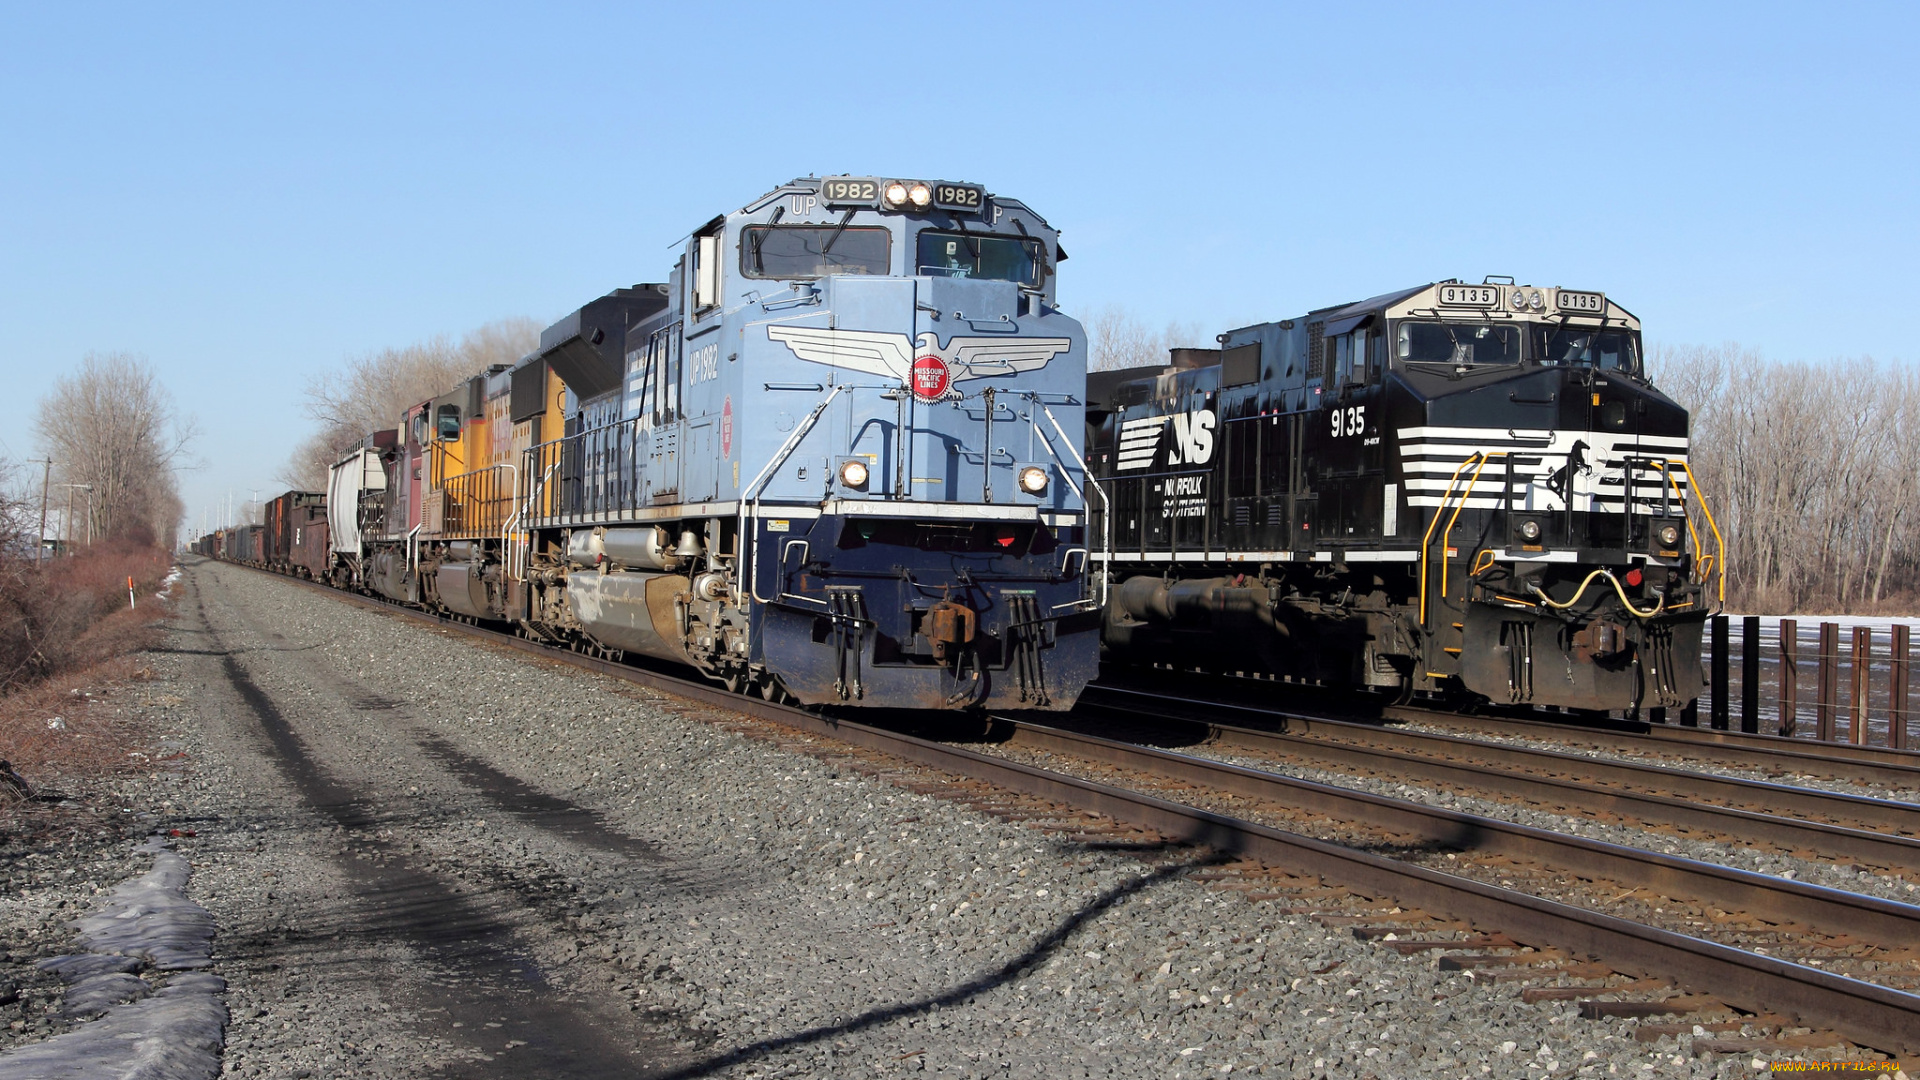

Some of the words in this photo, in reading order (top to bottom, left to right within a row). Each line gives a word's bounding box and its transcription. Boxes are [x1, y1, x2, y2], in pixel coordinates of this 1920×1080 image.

[828, 183, 874, 199] 1982
[938, 187, 978, 205] 1982
[791, 195, 816, 215] UP
[1447, 289, 1489, 302] 9135
[1562, 294, 1596, 308] 9135
[690, 350, 700, 386] UP
[700, 343, 718, 382] 1982
[914, 367, 945, 375] MISSOURI
[917, 374, 940, 382] PACIFIC
[1331, 406, 1365, 437] 9135
[1168, 410, 1216, 465] NS
